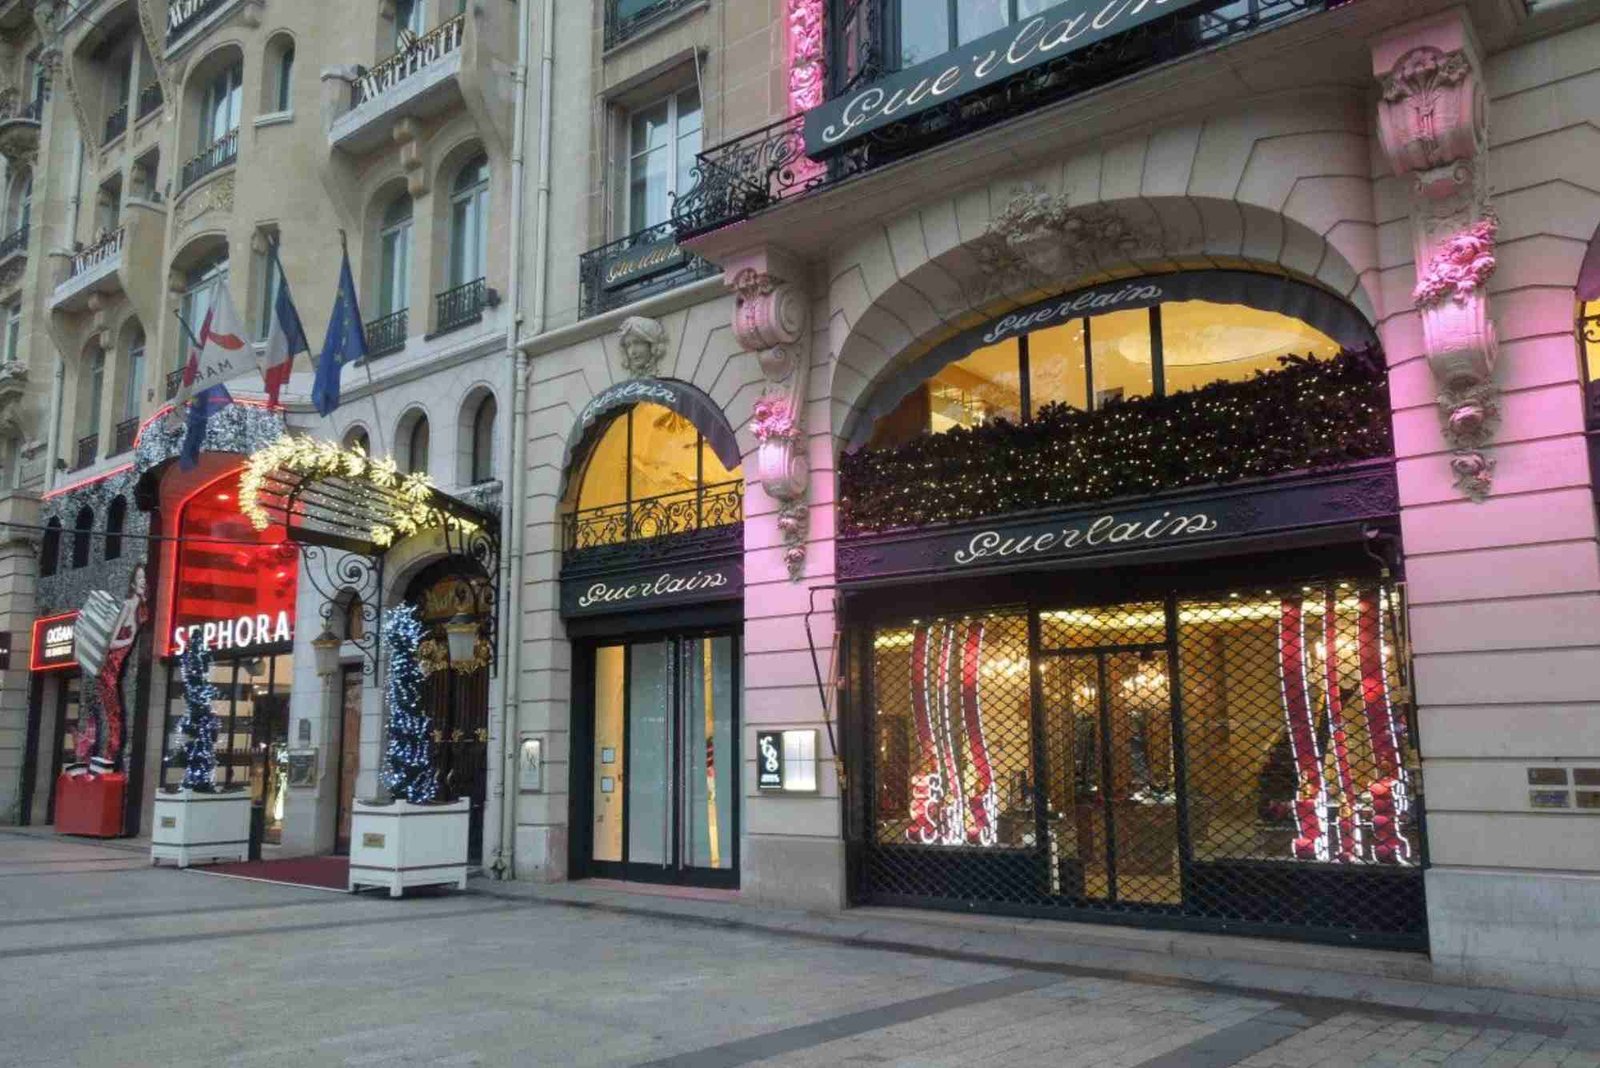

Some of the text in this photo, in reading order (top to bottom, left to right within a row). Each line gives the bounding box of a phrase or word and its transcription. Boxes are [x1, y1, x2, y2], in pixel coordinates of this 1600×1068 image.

[822, 0, 1168, 143] Guerlai
[983, 284, 1163, 343] Guerlain
[954, 511, 1217, 563] Guerlain
[578, 570, 728, 607] Guerlain
